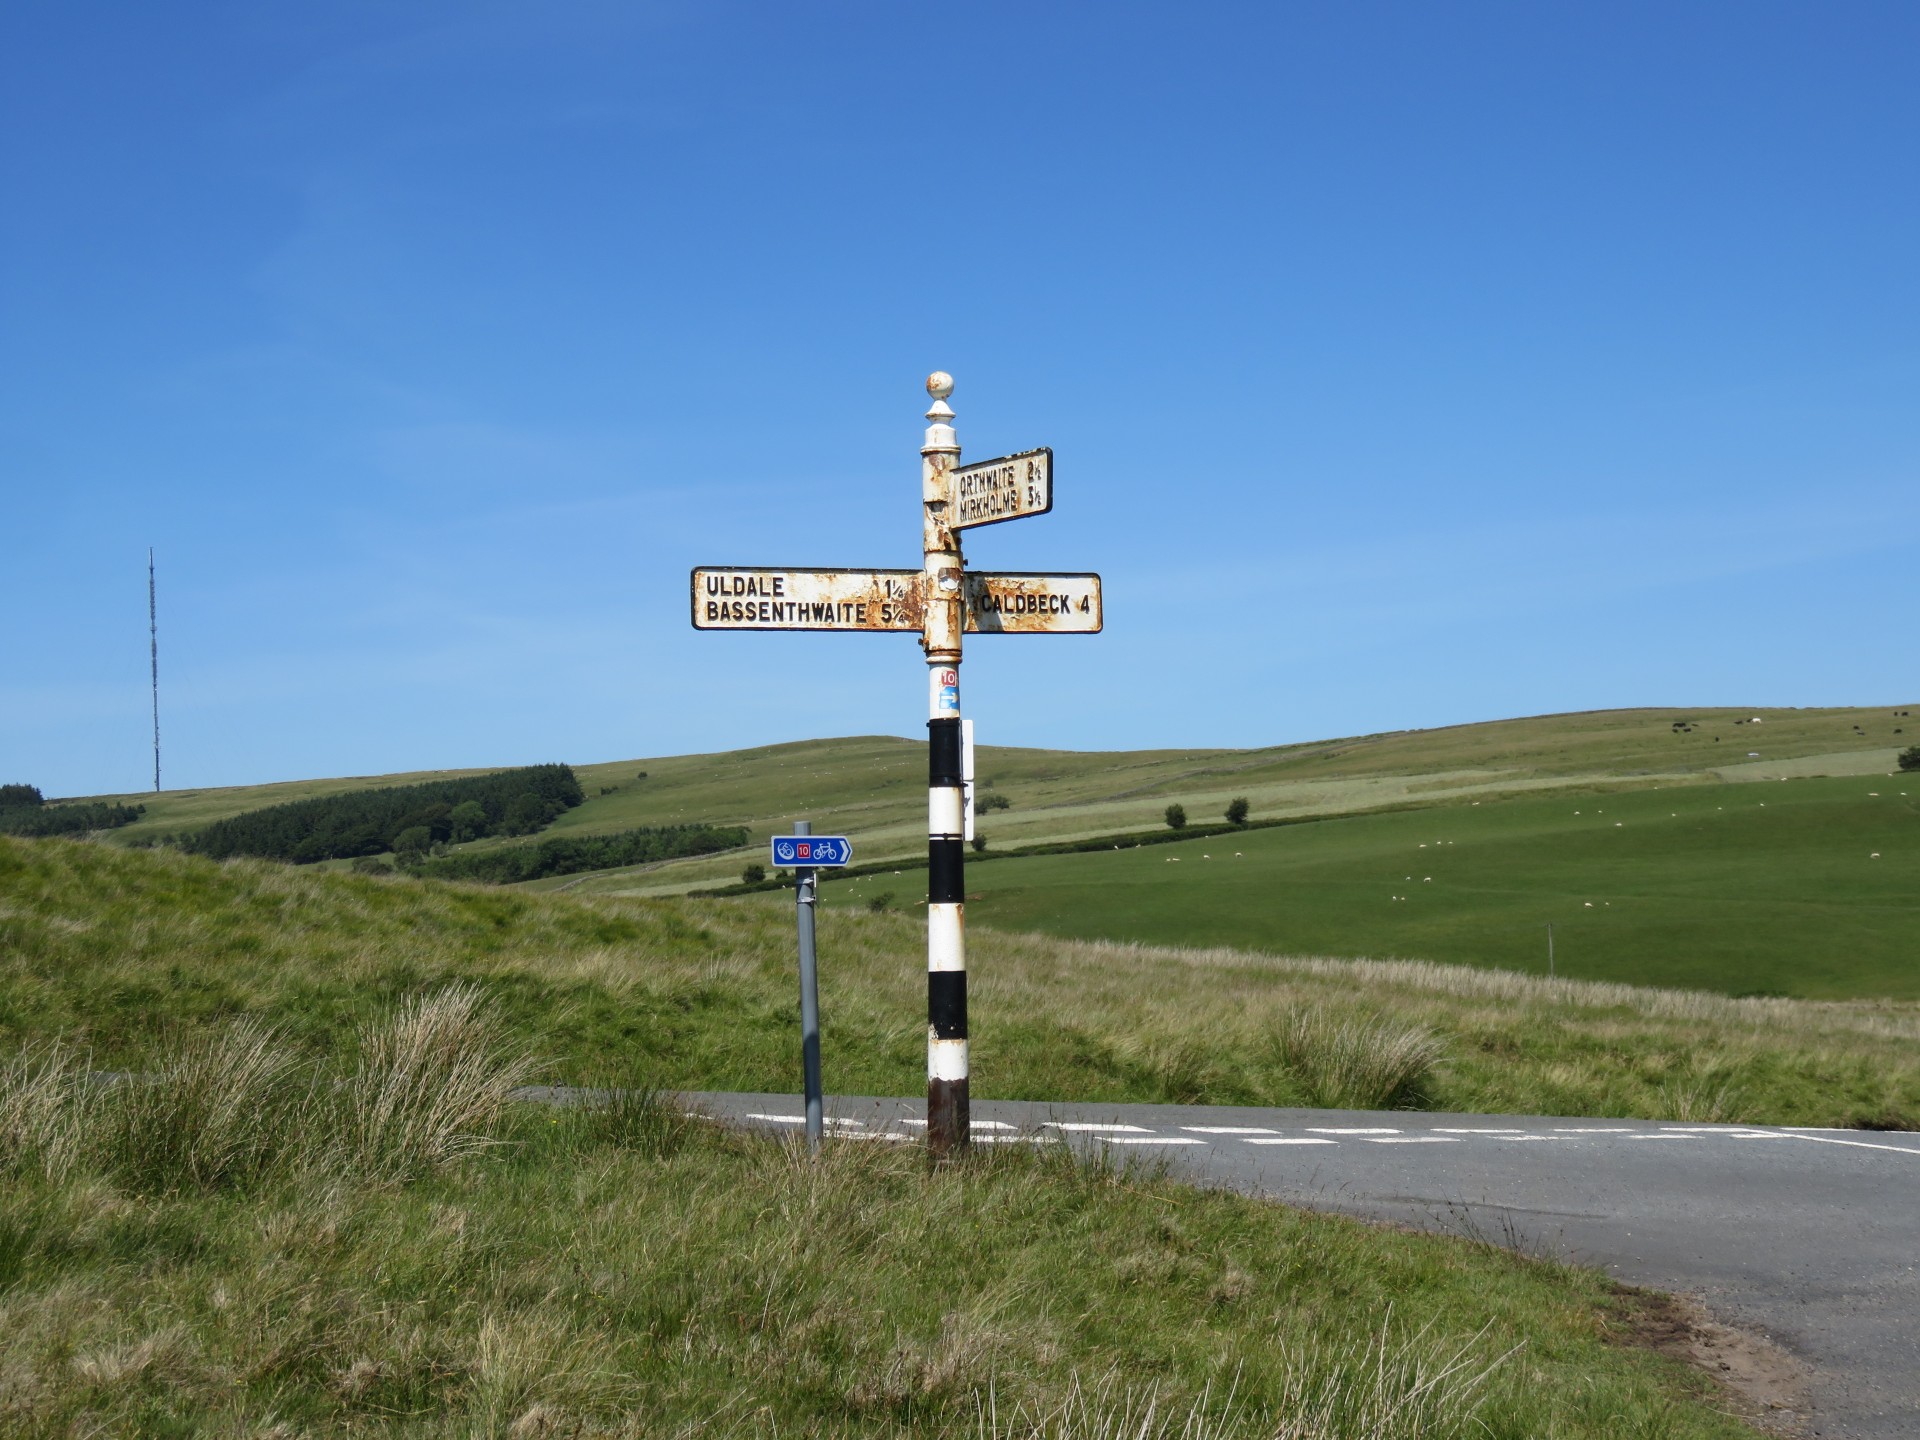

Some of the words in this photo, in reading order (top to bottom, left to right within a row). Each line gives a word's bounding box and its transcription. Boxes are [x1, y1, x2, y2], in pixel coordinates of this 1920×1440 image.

[960, 465, 1014, 497] ORTHWAITE
[960, 489, 1017, 521] MIRKHOLME
[707, 576, 784, 597] ULDALE
[707, 601, 867, 623] BASSENTHWAITE
[981, 594, 1070, 614] CALDBECK
[1080, 594, 1090, 614] 4
[942, 672, 955, 683] 10
[799, 846, 809, 856] 10
